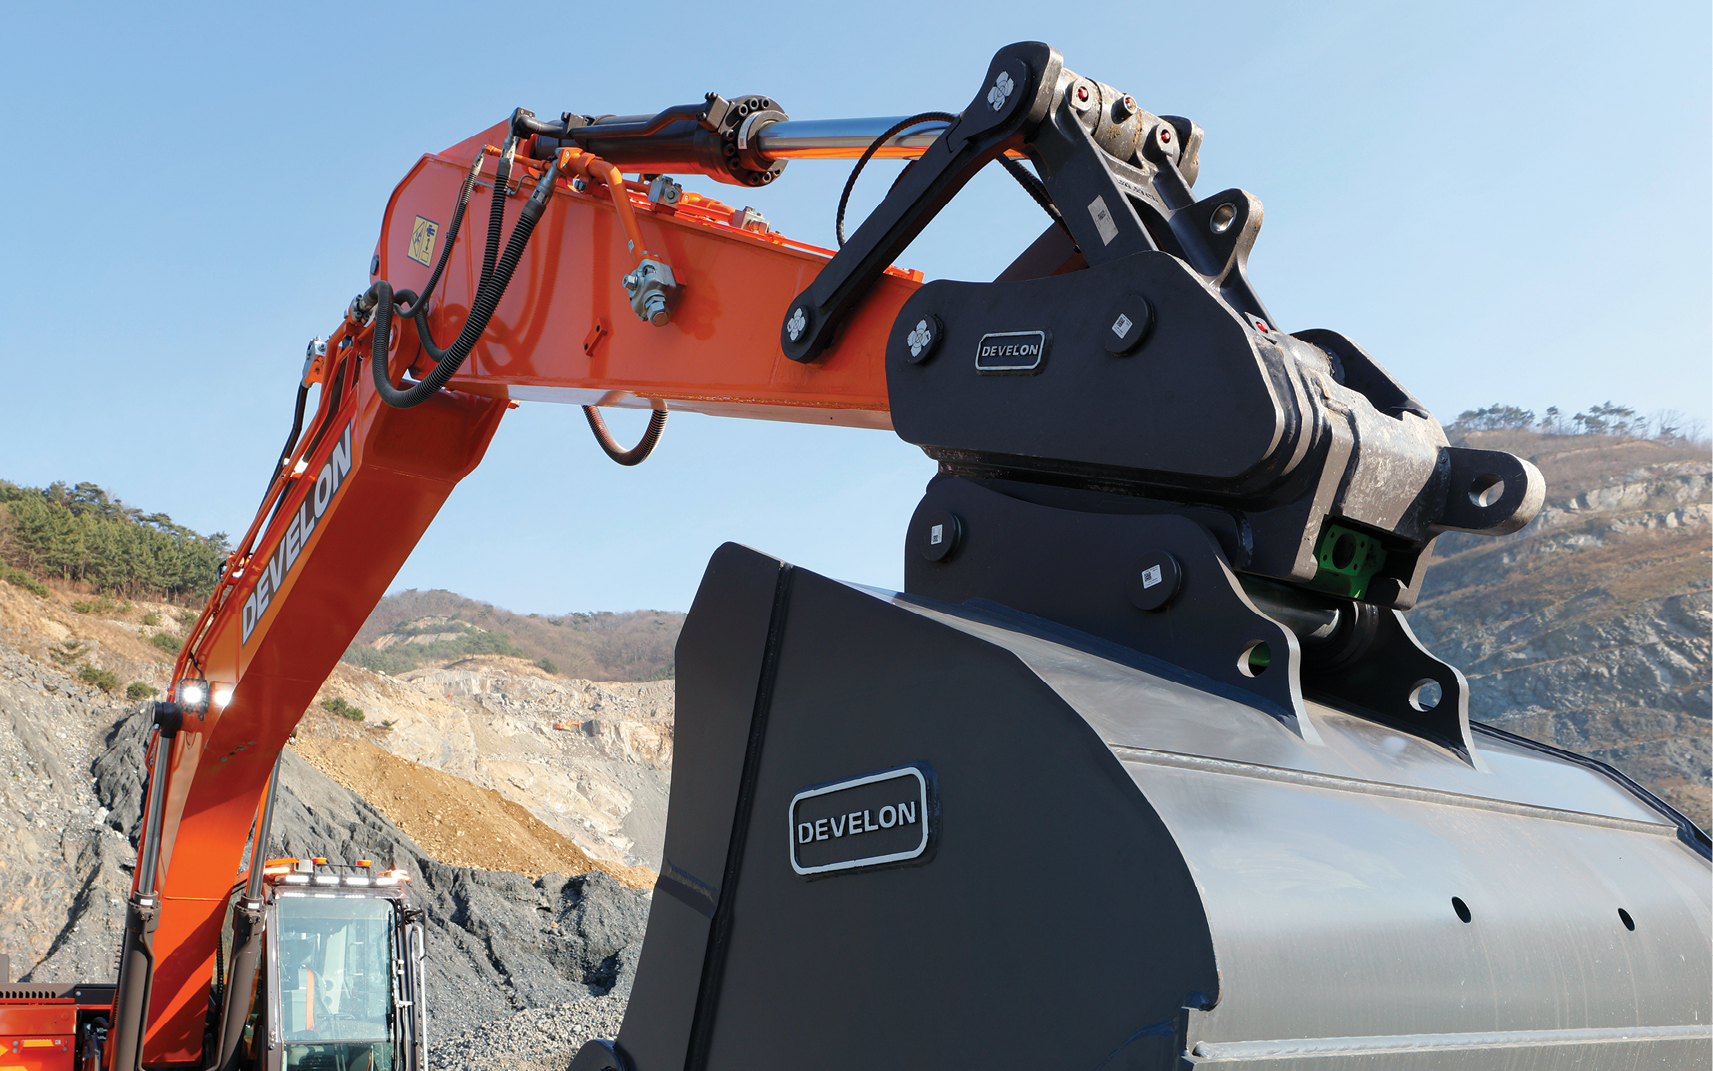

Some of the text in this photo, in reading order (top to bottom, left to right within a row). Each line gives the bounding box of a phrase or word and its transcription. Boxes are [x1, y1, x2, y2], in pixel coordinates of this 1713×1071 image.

[982, 344, 1039, 357] DEVELON
[242, 422, 351, 646] DEVELON
[798, 801, 916, 844] DEVELON
